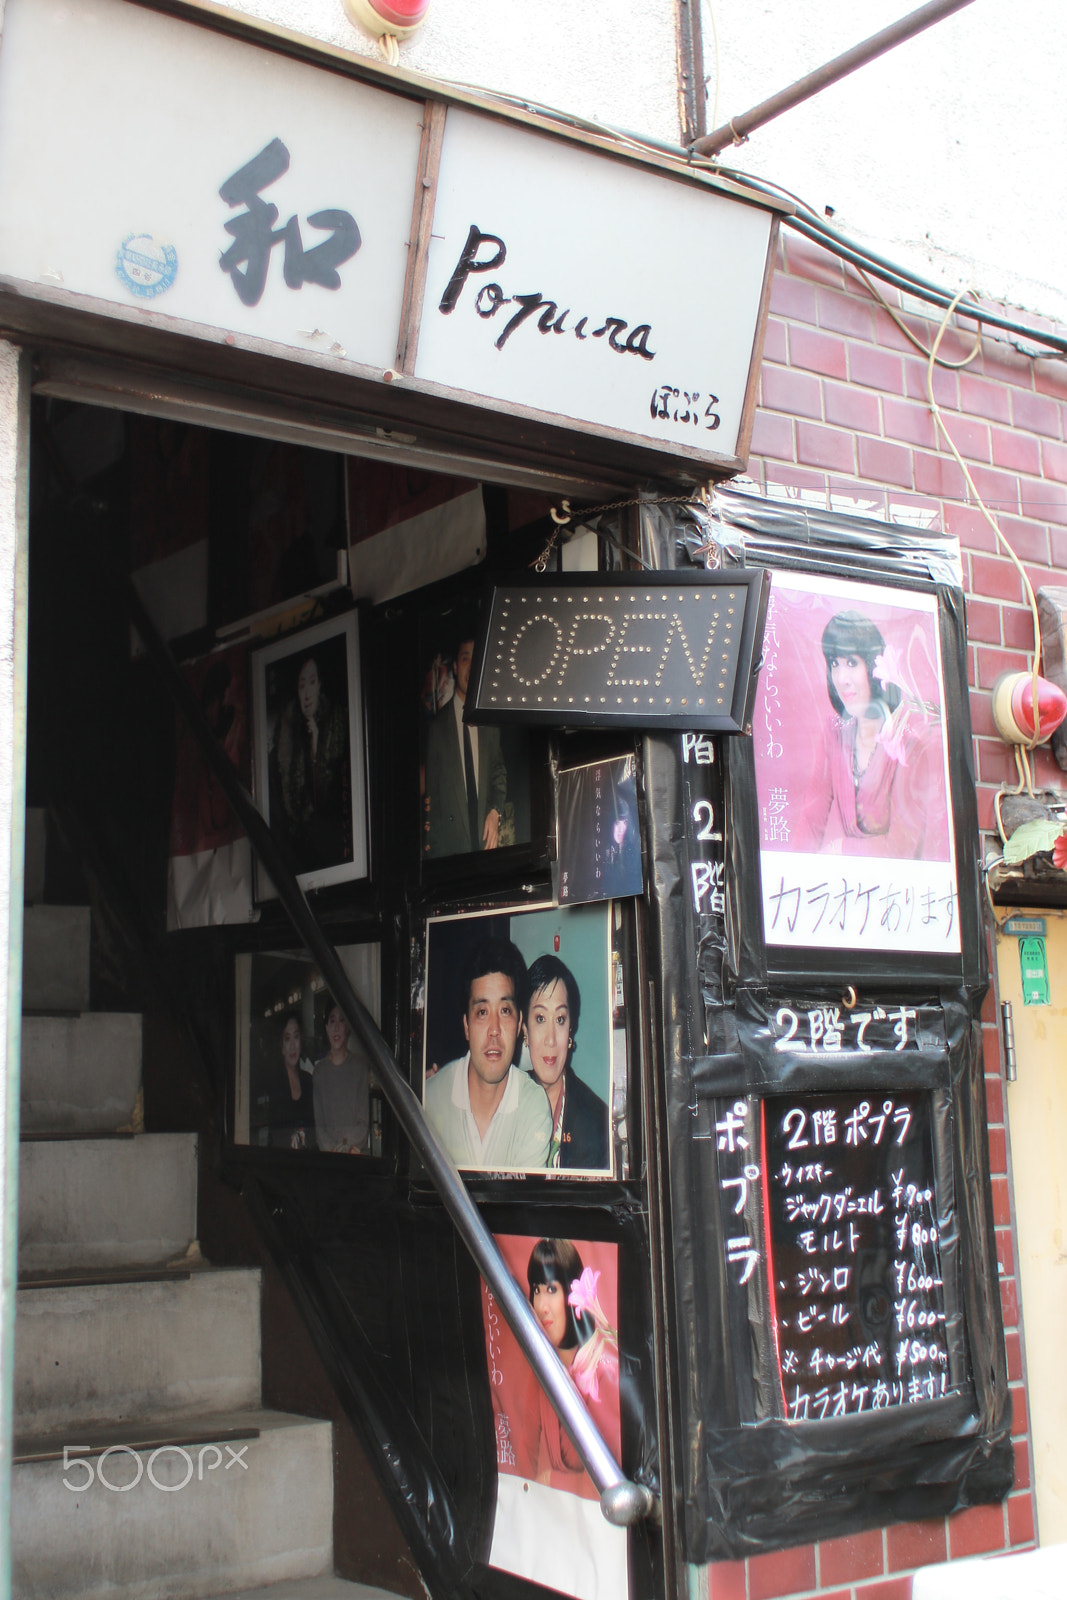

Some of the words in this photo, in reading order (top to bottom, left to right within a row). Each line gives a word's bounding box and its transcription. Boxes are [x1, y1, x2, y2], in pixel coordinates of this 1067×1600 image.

[218, 138, 361, 307] 和
[510, 614, 719, 687] OPEN
[767, 787, 791, 842] 夢路
[769, 876, 959, 938] カラオケあります
[775, 1006, 917, 1053] 2階です
[716, 1101, 760, 1286] ポプラ
[785, 1187, 885, 1224] ジャックダニエル
[800, 1222, 861, 1253] モルト
[798, 1303, 850, 1332] ビール
